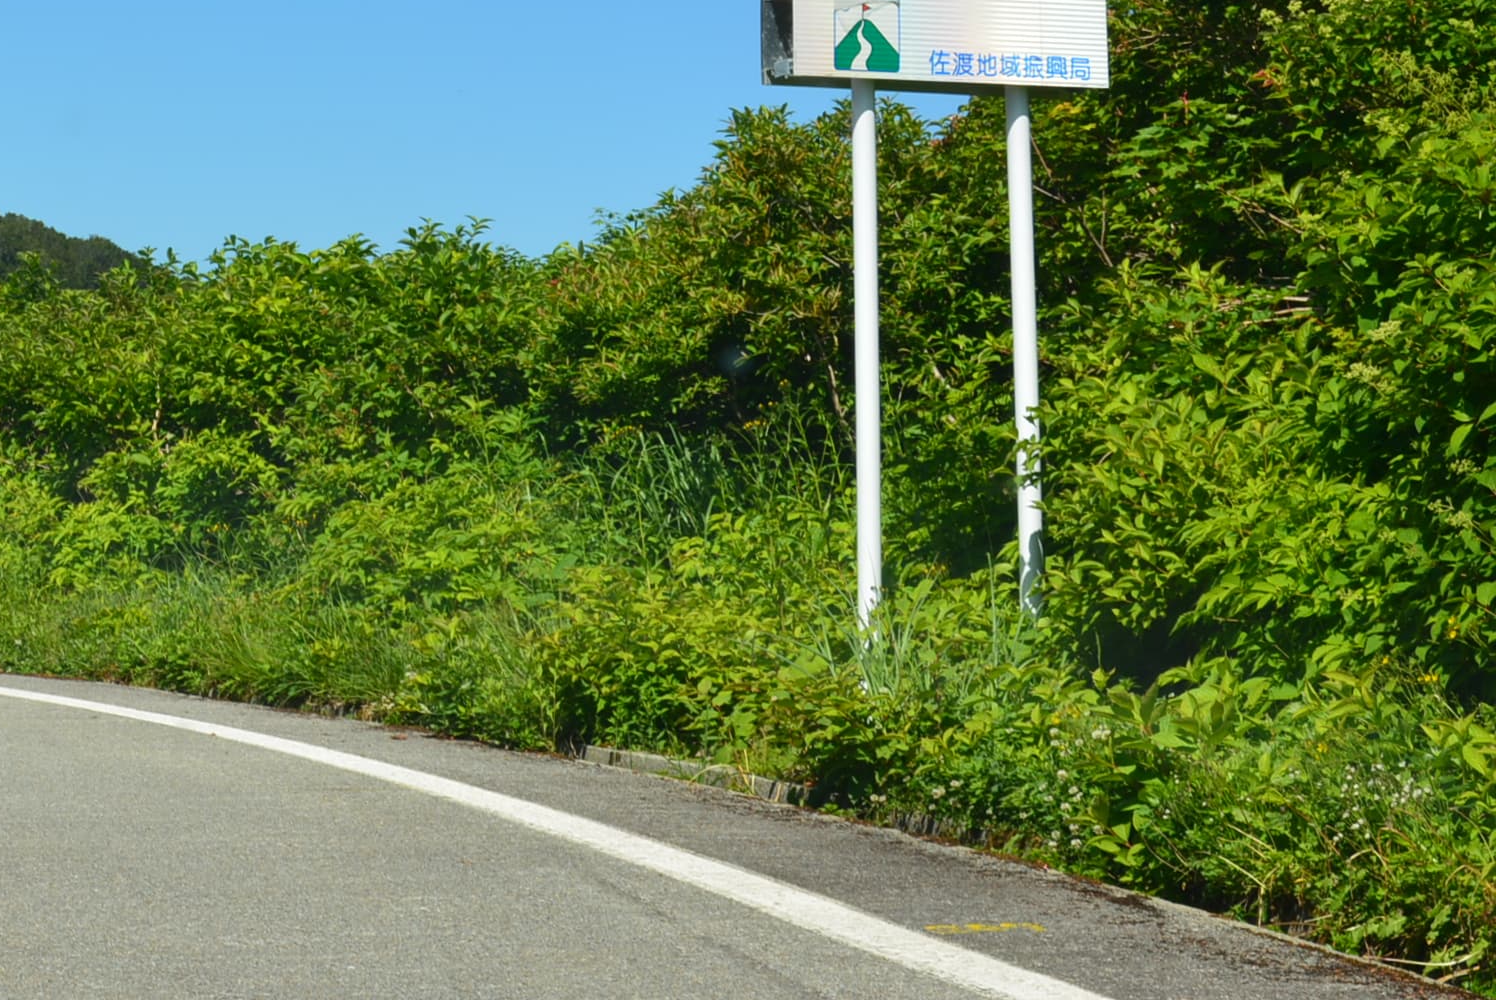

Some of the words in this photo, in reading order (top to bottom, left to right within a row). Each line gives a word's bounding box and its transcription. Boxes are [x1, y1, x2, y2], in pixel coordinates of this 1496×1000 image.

[928, 50, 1092, 81] 佐渡地域振興局
